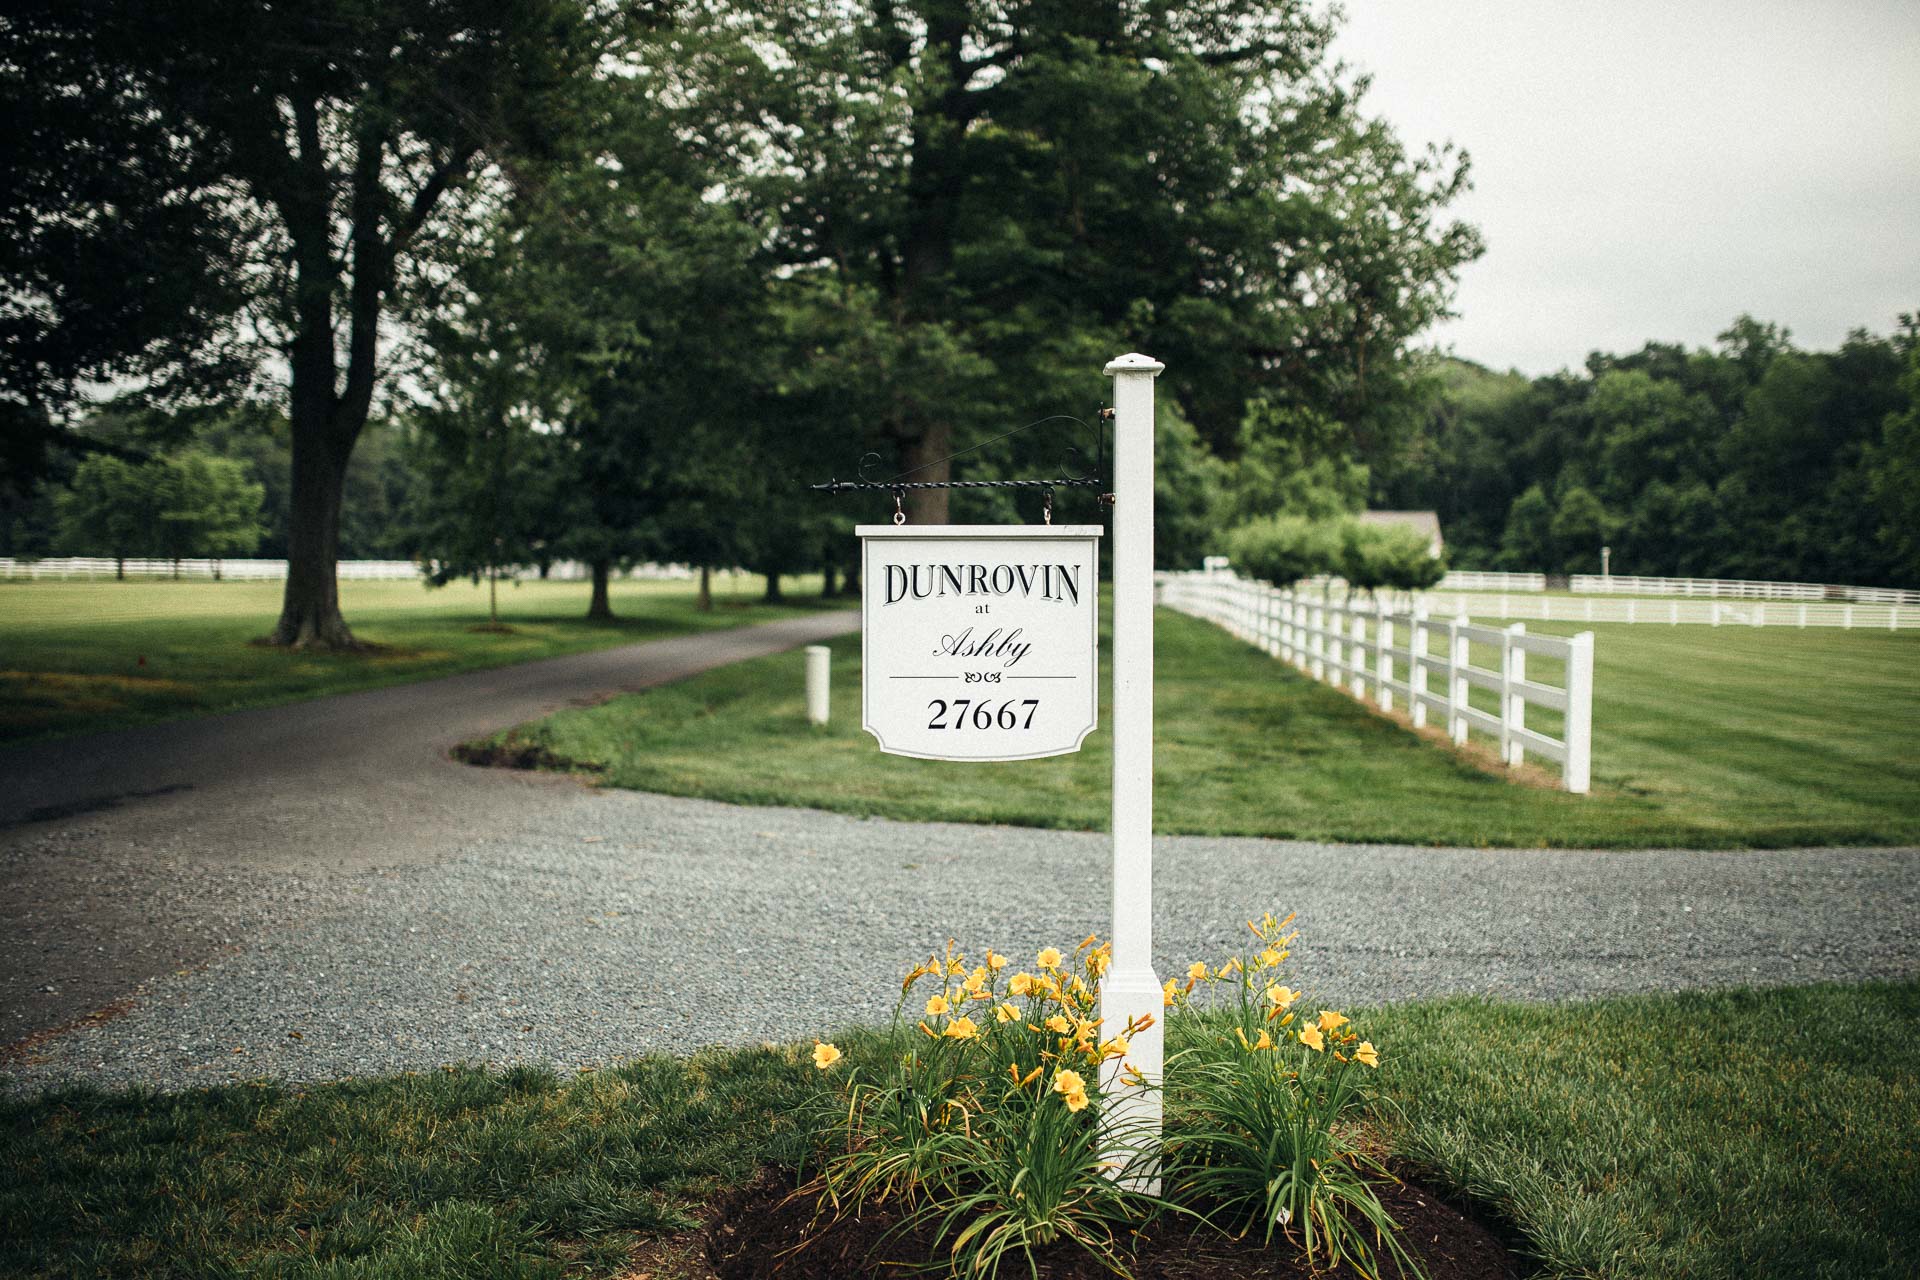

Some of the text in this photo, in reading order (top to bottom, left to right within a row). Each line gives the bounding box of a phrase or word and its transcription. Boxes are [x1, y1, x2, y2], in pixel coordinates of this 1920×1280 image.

[884, 564, 1081, 606] DUNROVIN
[975, 603, 990, 614] at
[932, 626, 1032, 667] Ashby
[927, 699, 1040, 730] 27667
